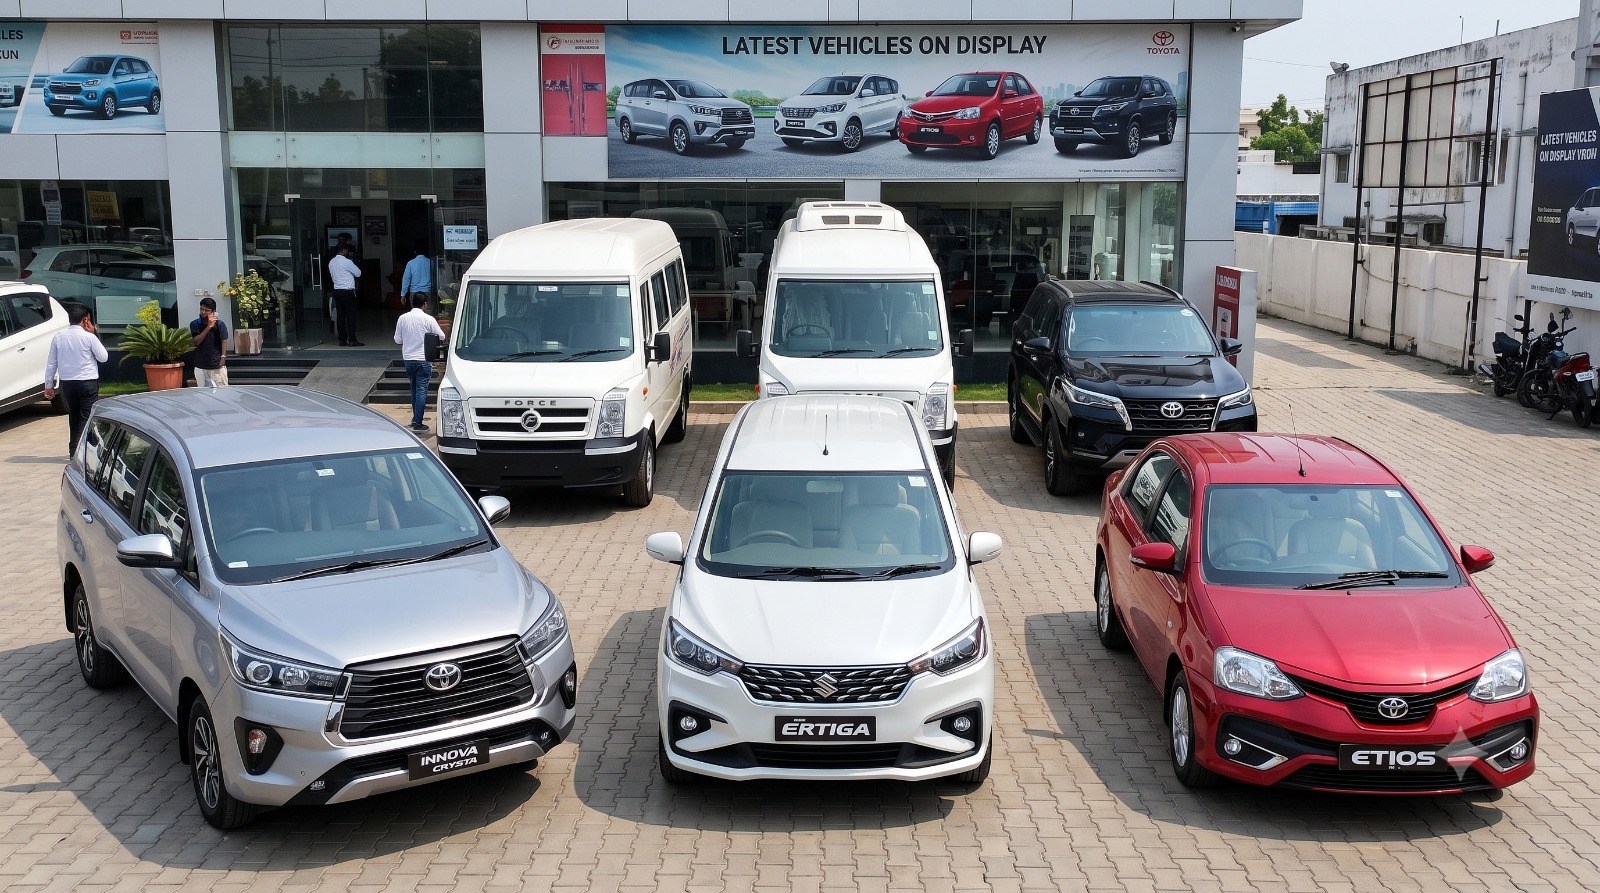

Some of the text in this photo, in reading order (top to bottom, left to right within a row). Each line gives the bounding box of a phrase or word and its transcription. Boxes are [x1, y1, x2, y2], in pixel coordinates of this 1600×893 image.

[0, 30, 24, 40] LES
[722, 35, 1048, 55] LATEST VEHICLES ON DISPLAY
[1147, 47, 1180, 55] TOYOTA
[0, 50, 19, 60] UN
[1541, 130, 1597, 146] LATEST VEHICLES
[1549, 149, 1577, 162] DISPLAY
[781, 722, 870, 736] ERTIGA
[421, 745, 478, 767] INNOVA
[1351, 750, 1436, 766] ETIOS
[432, 756, 478, 773] CRYSTA
